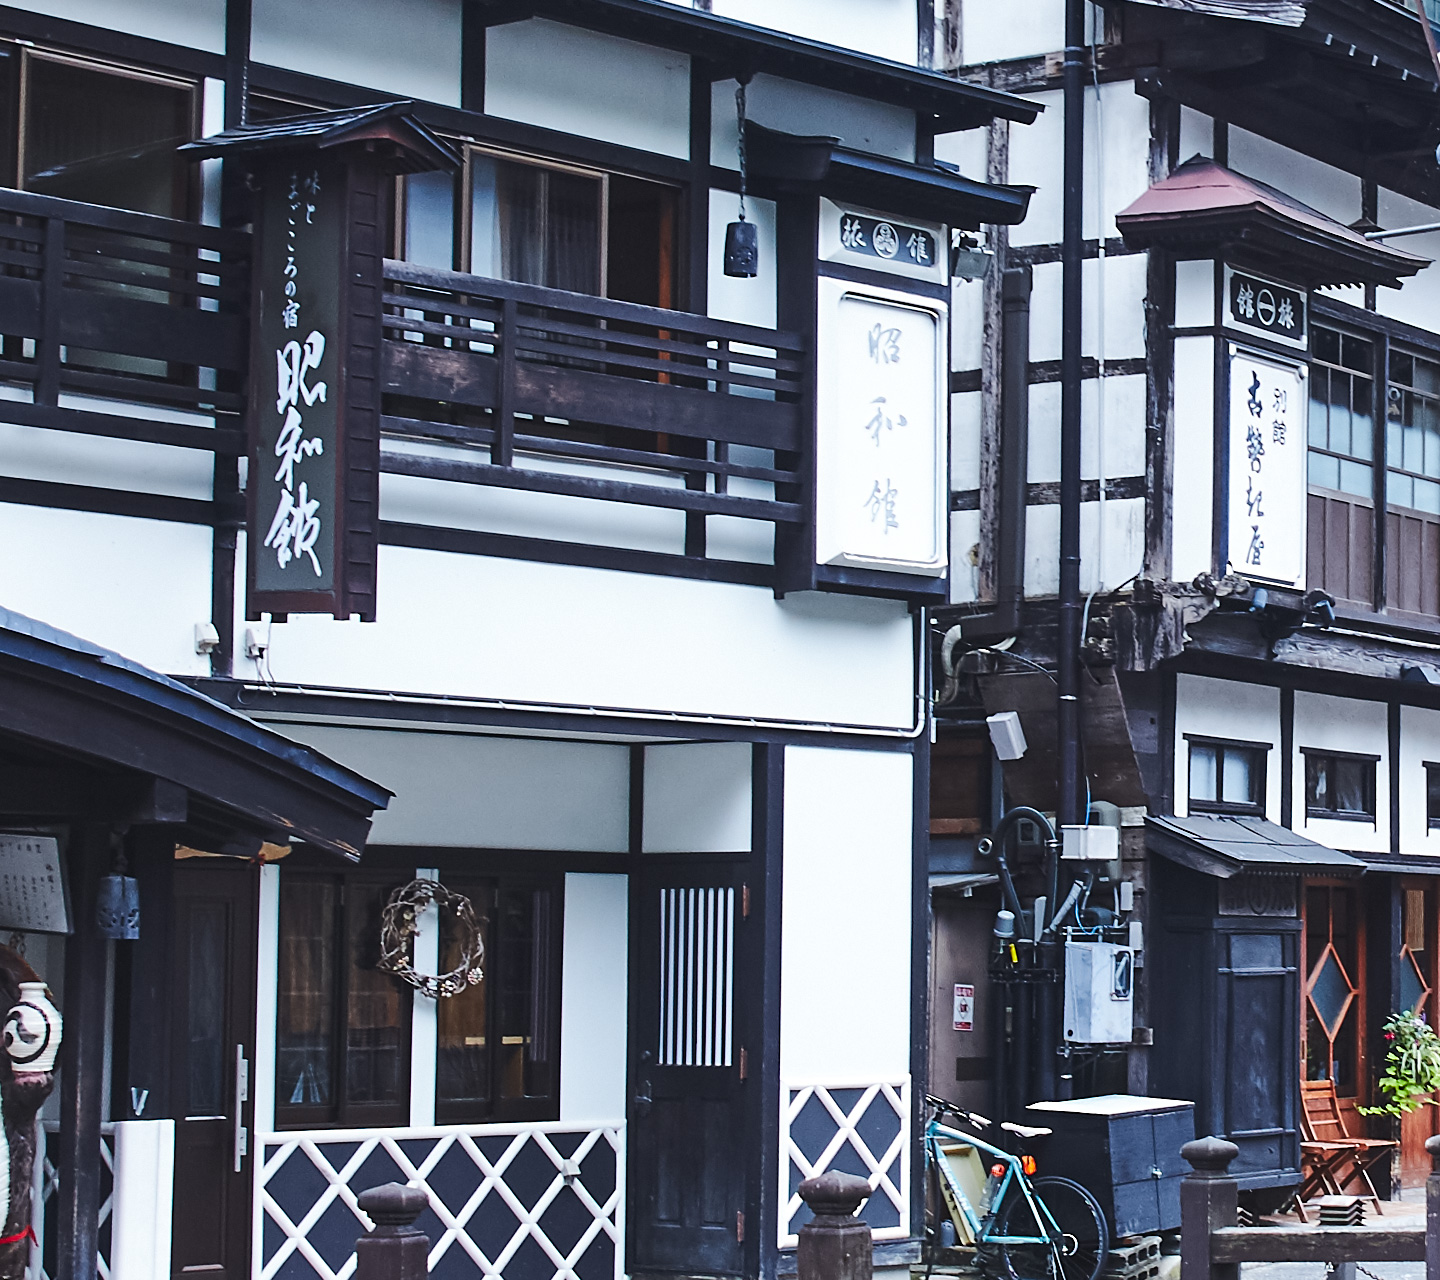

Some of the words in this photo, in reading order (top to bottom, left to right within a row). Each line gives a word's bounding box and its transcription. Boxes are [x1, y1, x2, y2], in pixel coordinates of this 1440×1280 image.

[842, 218, 930, 264] 旅館
[264, 331, 327, 577] 昭和館
[864, 322, 908, 535] 昭和館
[1272, 387, 1287, 446] 別館
